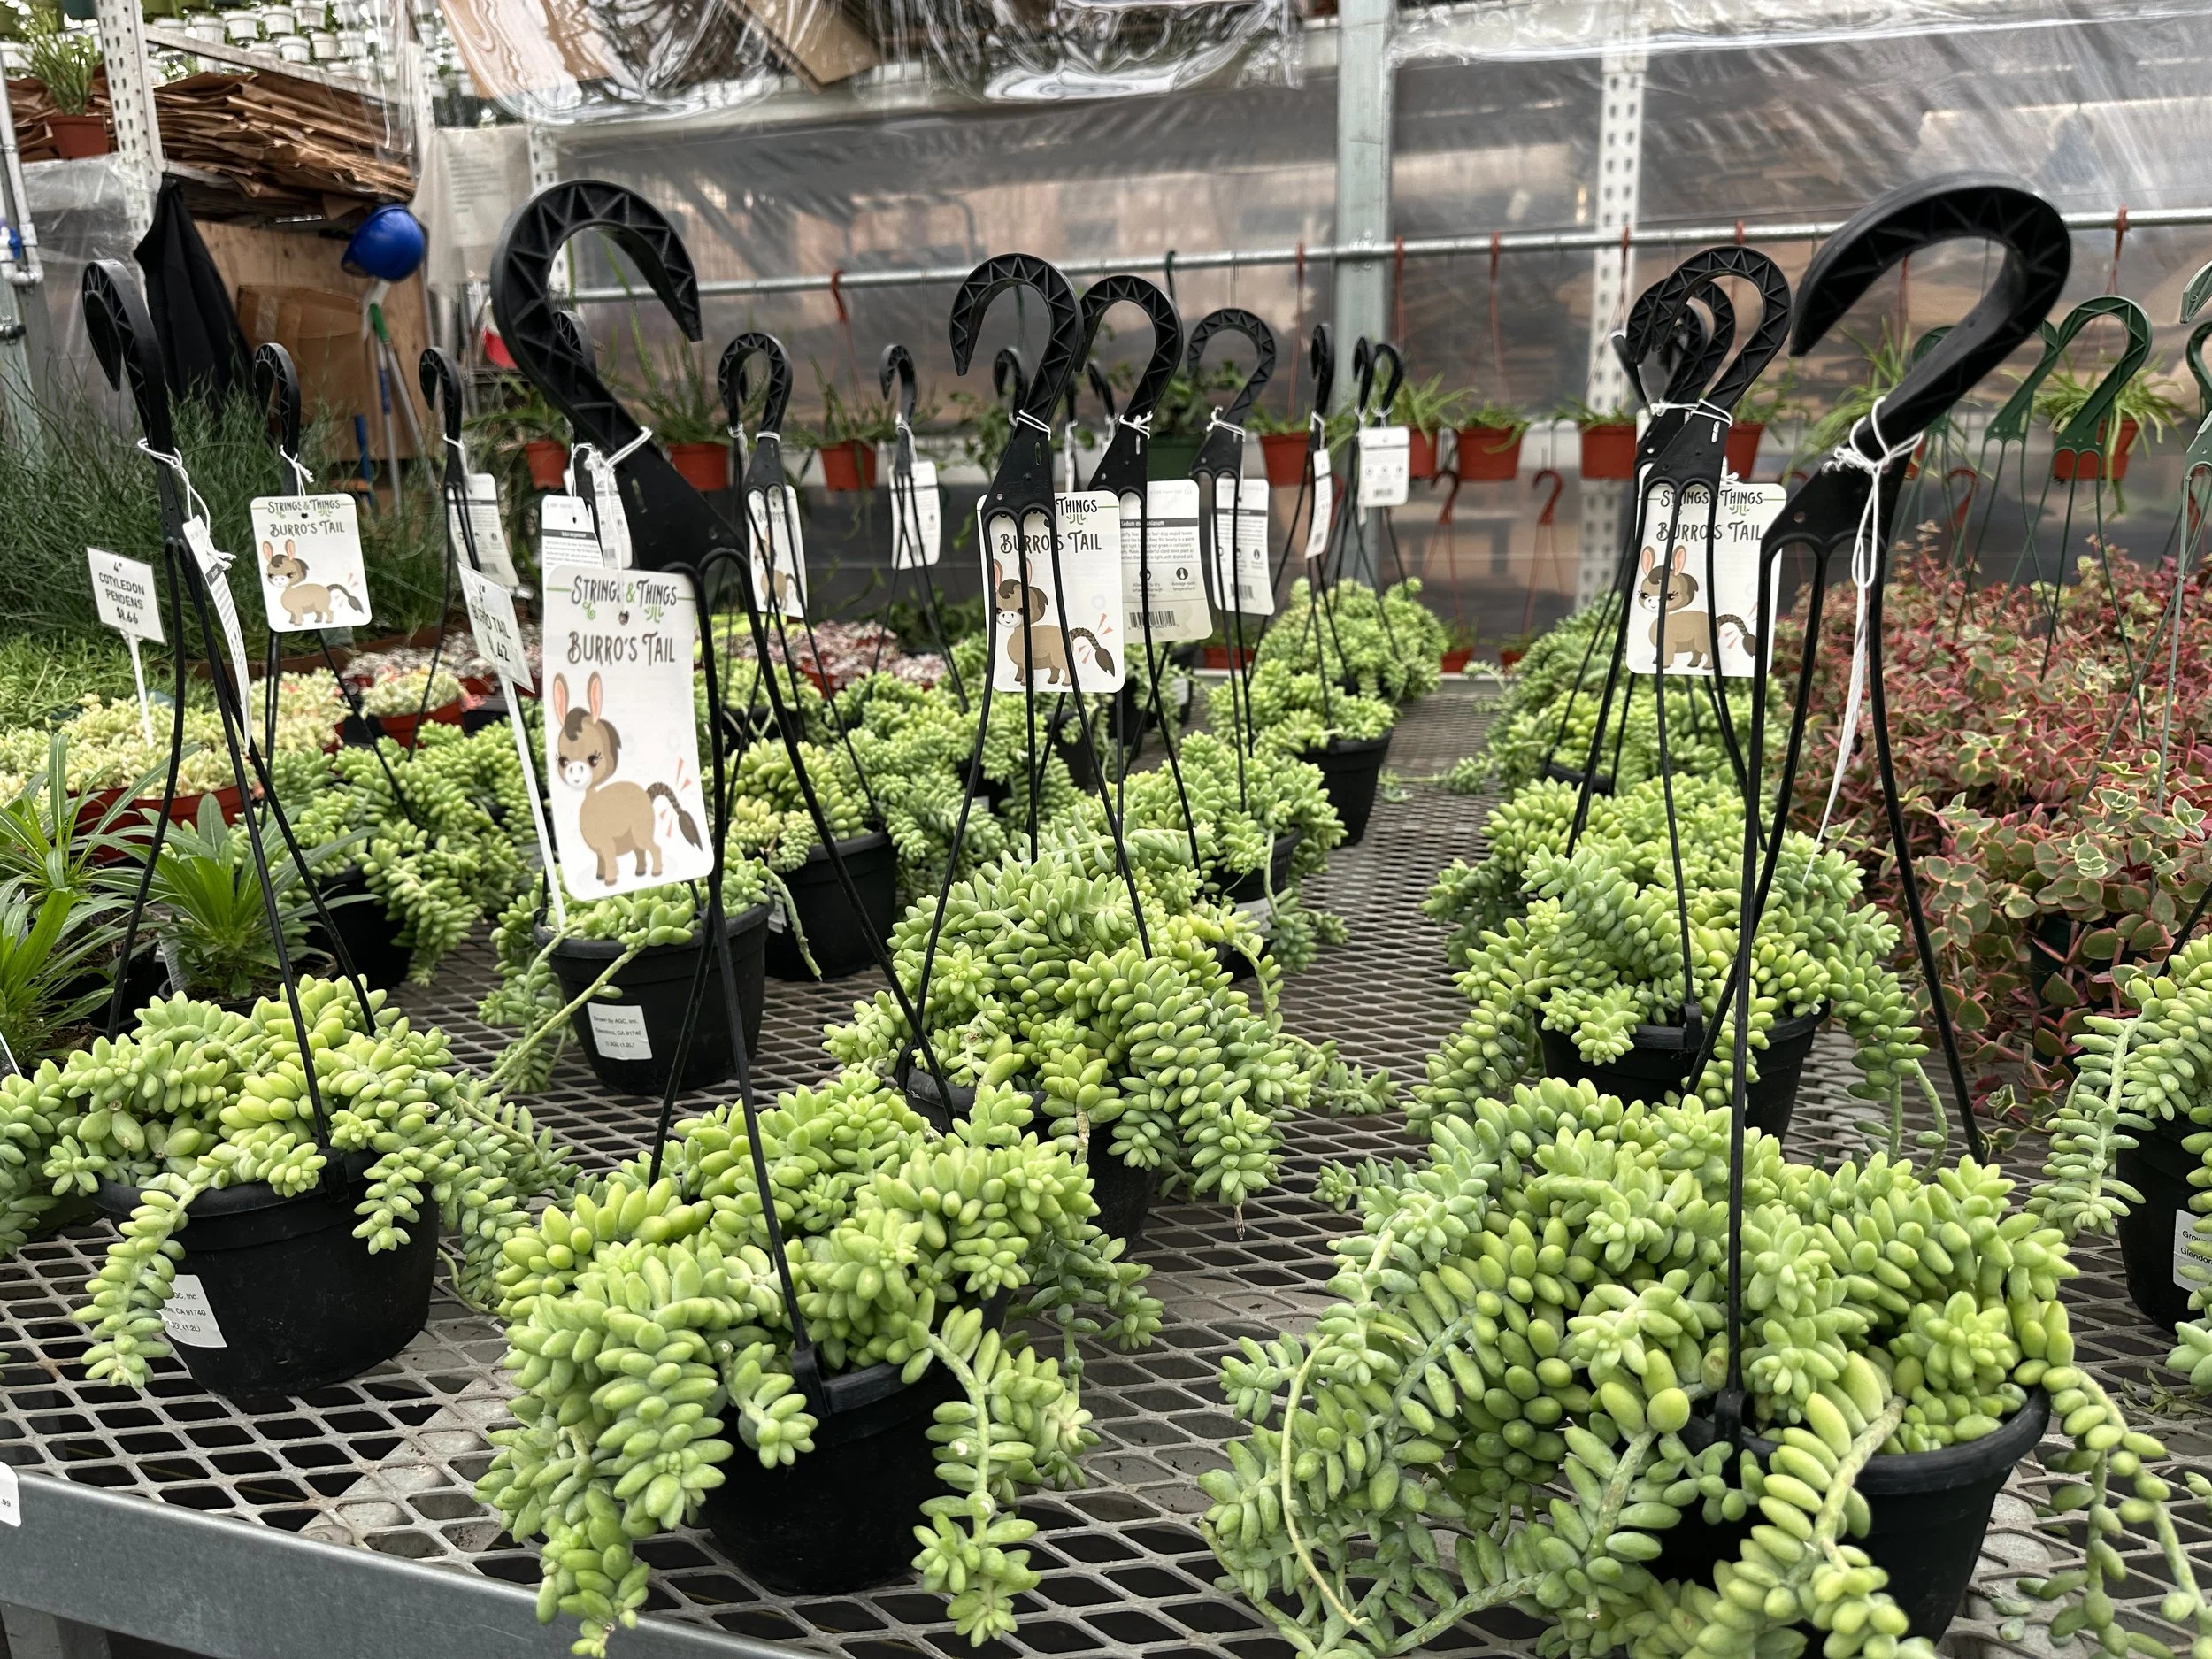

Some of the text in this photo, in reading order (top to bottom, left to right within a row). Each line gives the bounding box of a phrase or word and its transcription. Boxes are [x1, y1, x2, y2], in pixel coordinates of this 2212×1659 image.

[267, 501, 302, 514] STRINGS
[310, 498, 341, 511] THINGS
[1055, 496, 1098, 516] THINGS
[1660, 488, 1763, 508] STINGS THINGS
[269, 519, 345, 538] BURRO'S TAIL
[1655, 520, 1763, 543] BURROS TAIL
[1000, 529, 1102, 555] BURROS TAIL
[571, 574, 678, 608] STRING & THINGS
[567, 630, 676, 667] BURRO'S TAIL
[2180, 1247, 2212, 1265] Glendor
